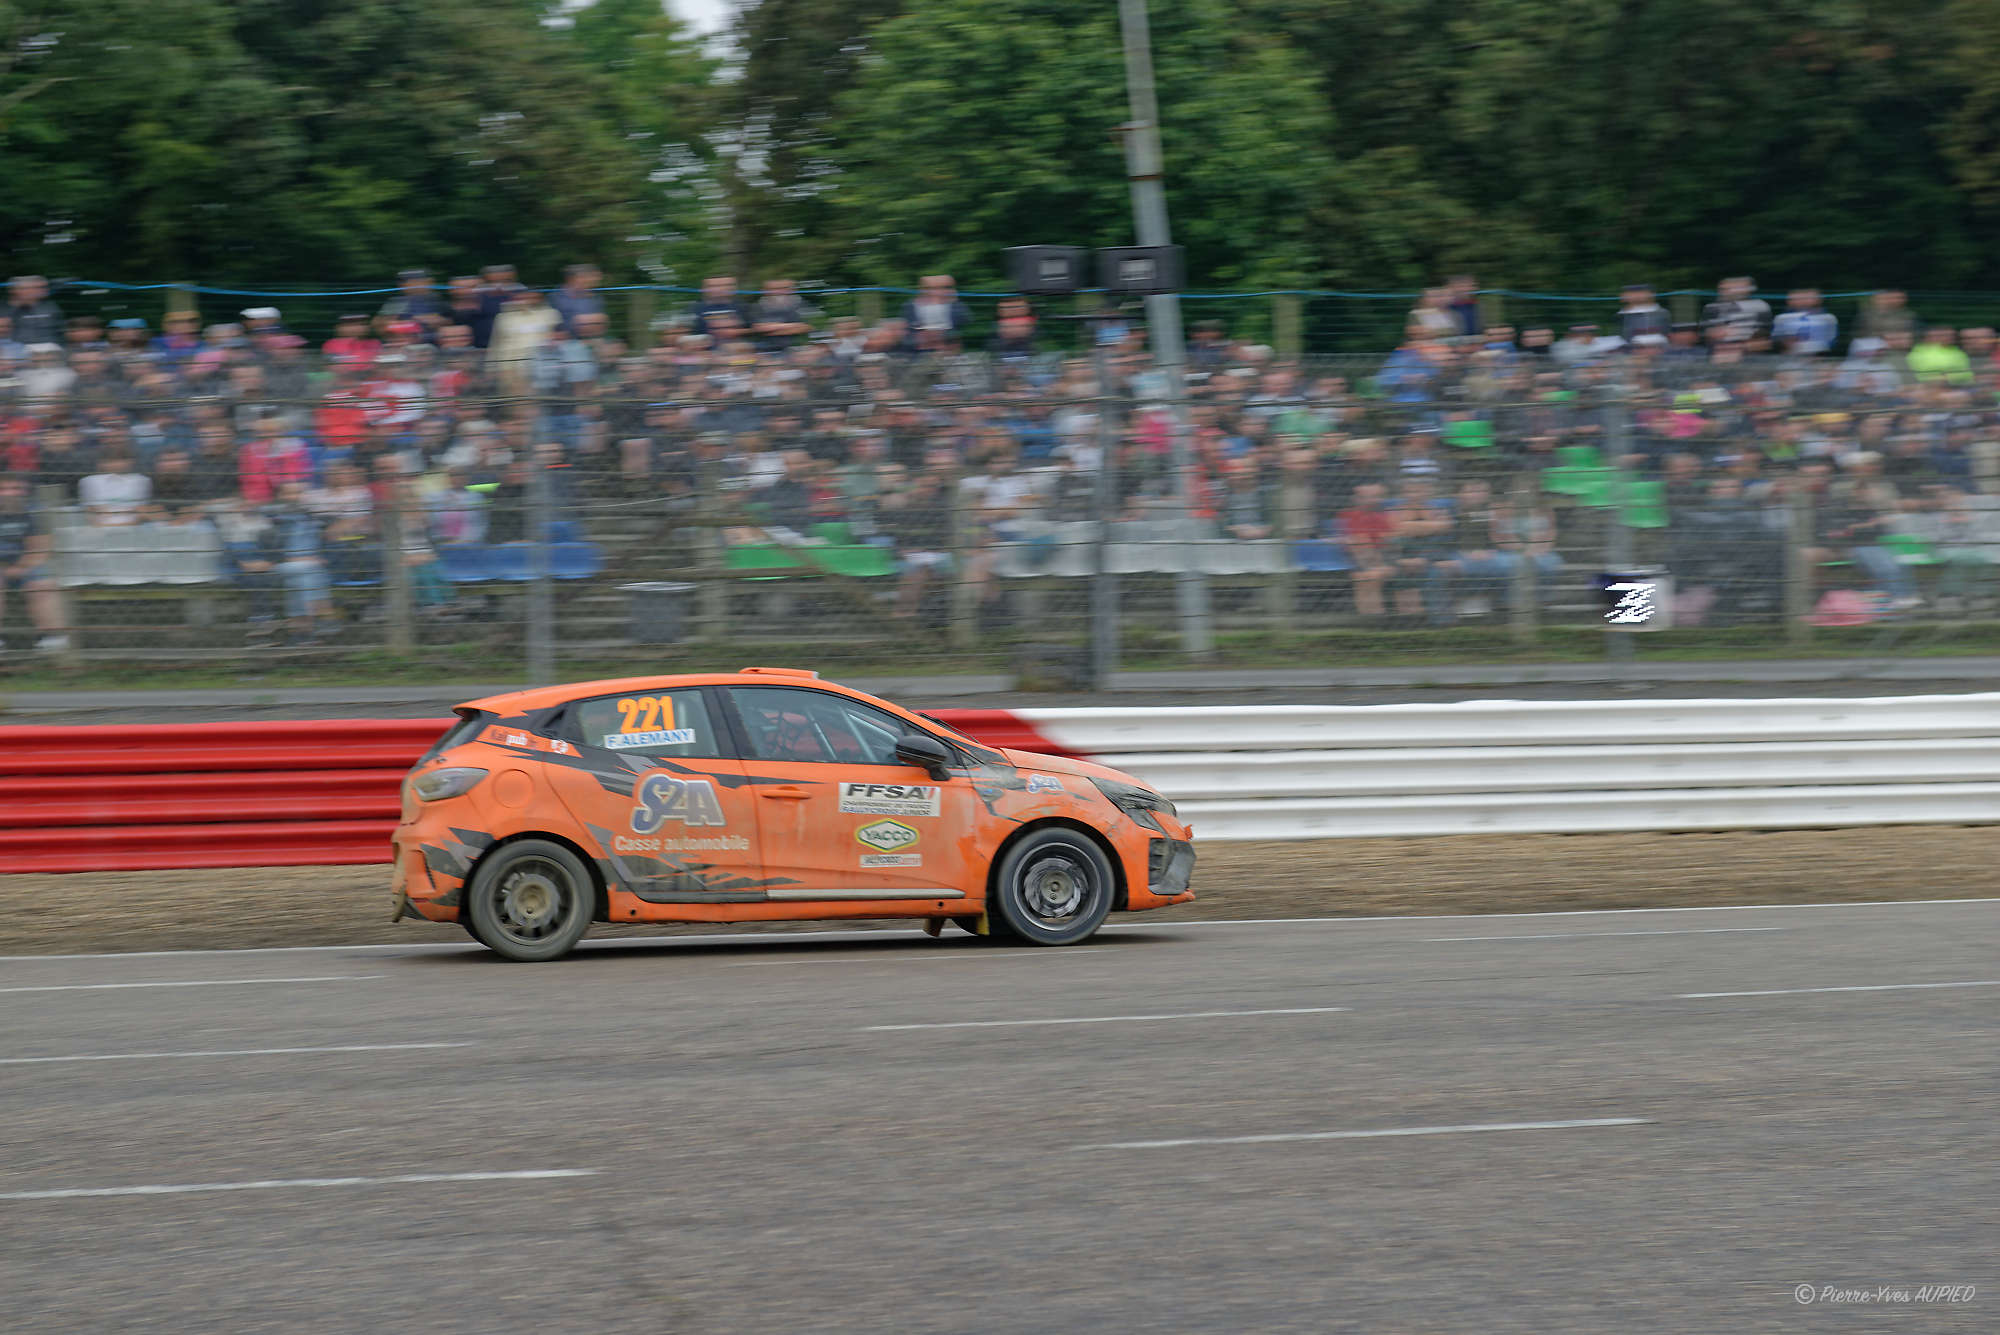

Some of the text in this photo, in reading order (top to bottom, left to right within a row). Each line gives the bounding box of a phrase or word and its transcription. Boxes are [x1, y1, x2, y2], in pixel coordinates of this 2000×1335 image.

[617, 696, 675, 734] 221
[847, 783, 924, 800] FFSA
[615, 835, 750, 851] Casse automobile
[865, 830, 912, 842] YACCO
